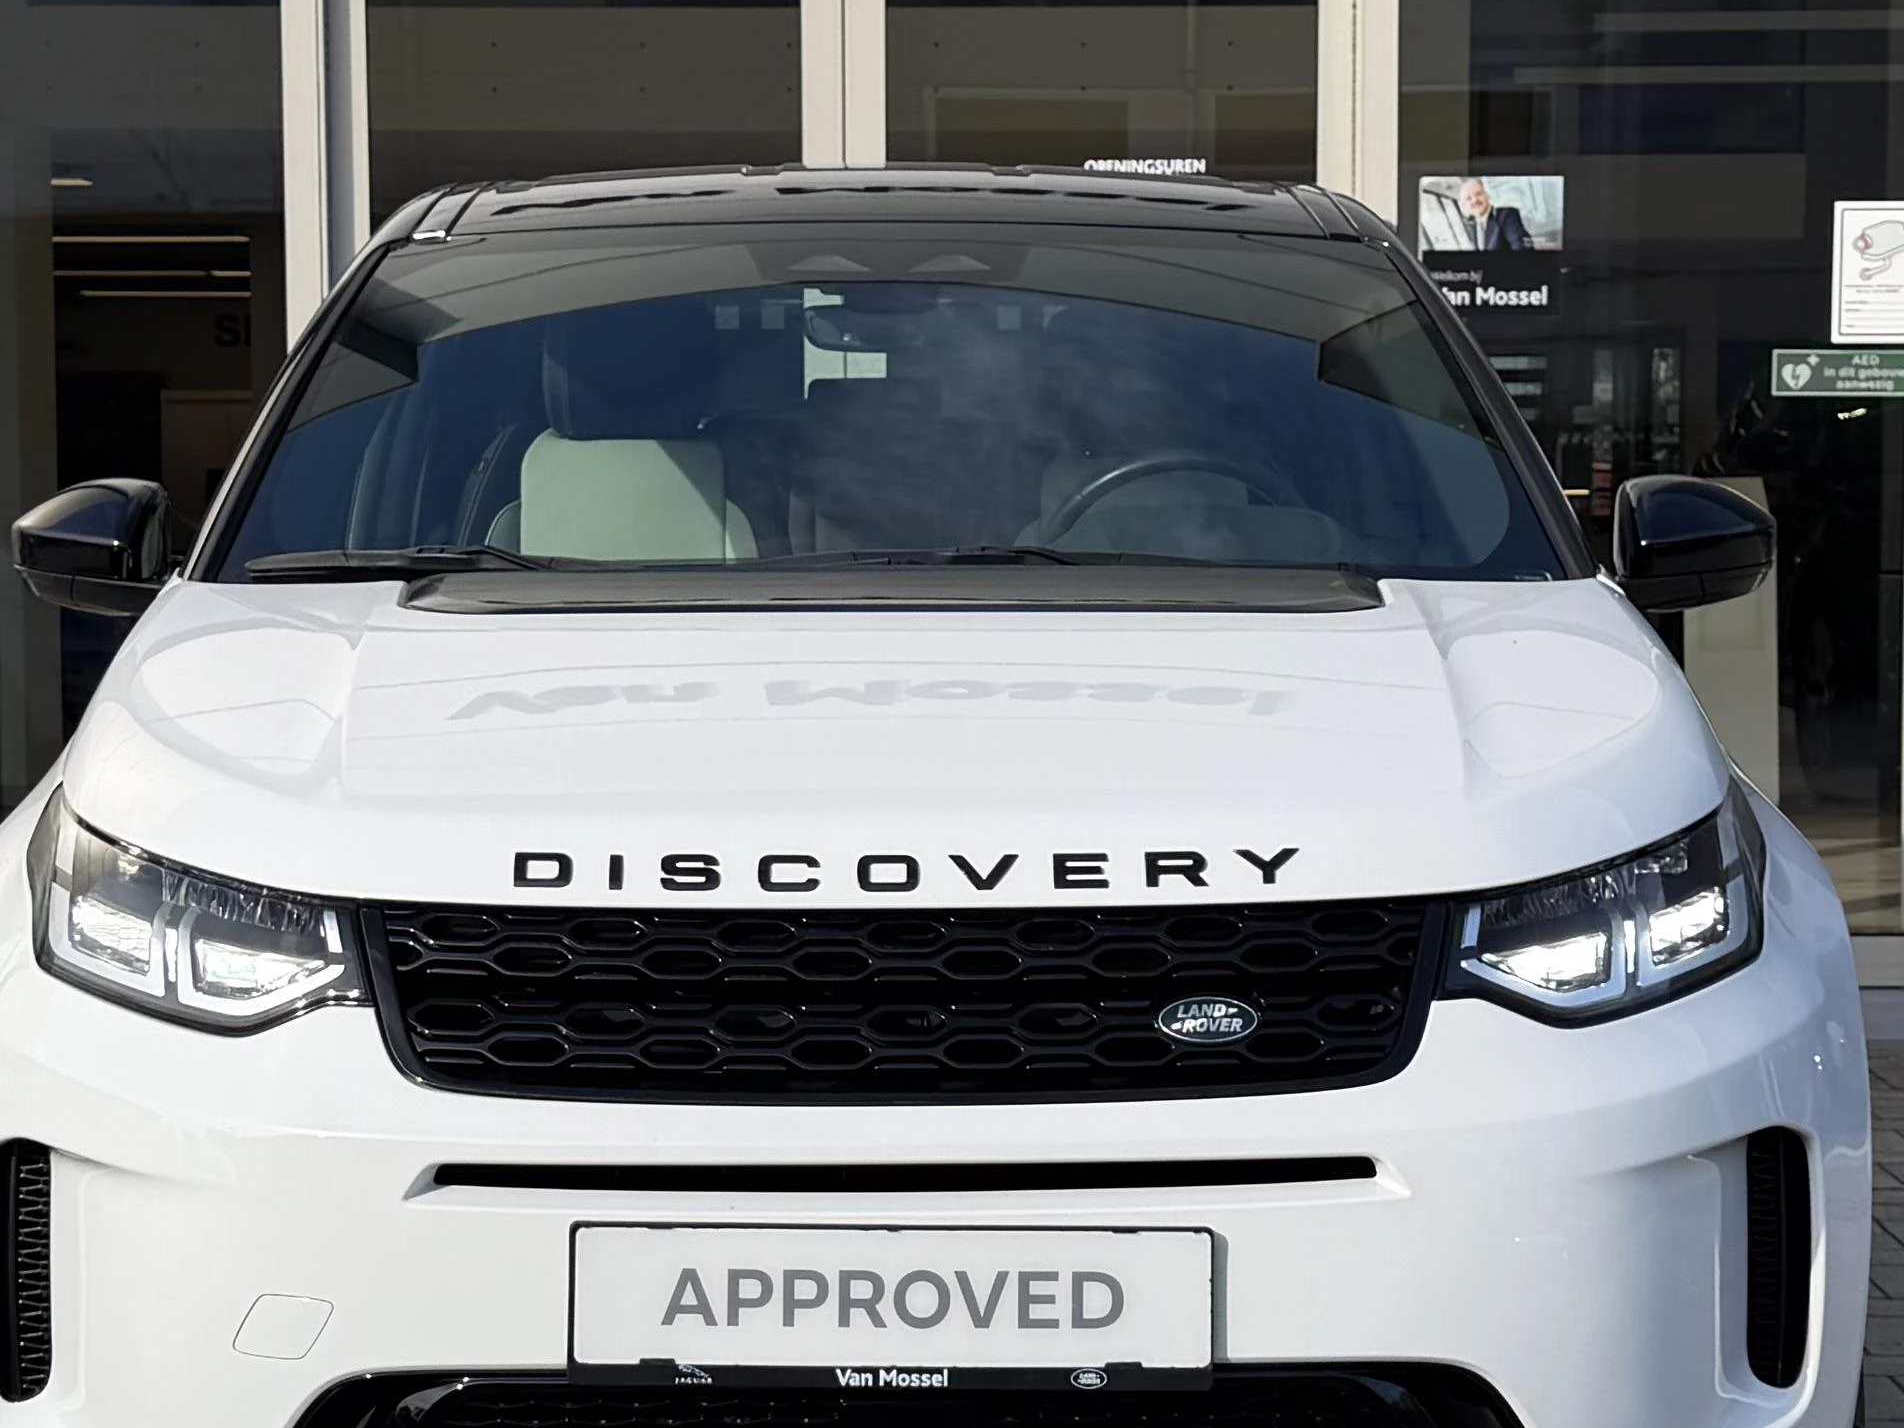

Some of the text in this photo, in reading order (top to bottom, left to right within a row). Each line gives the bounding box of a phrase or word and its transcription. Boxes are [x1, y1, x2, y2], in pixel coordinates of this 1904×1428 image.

[1475, 285, 1548, 306] Mossel
[1851, 354, 1880, 366] AED
[513, 847, 1300, 893] DISCOVERY
[1177, 1003, 1226, 1018] LAND
[1182, 1017, 1243, 1033] ROVER
[660, 1267, 1125, 1330] APPROVED
[836, 1368, 949, 1388] Van Mossel
